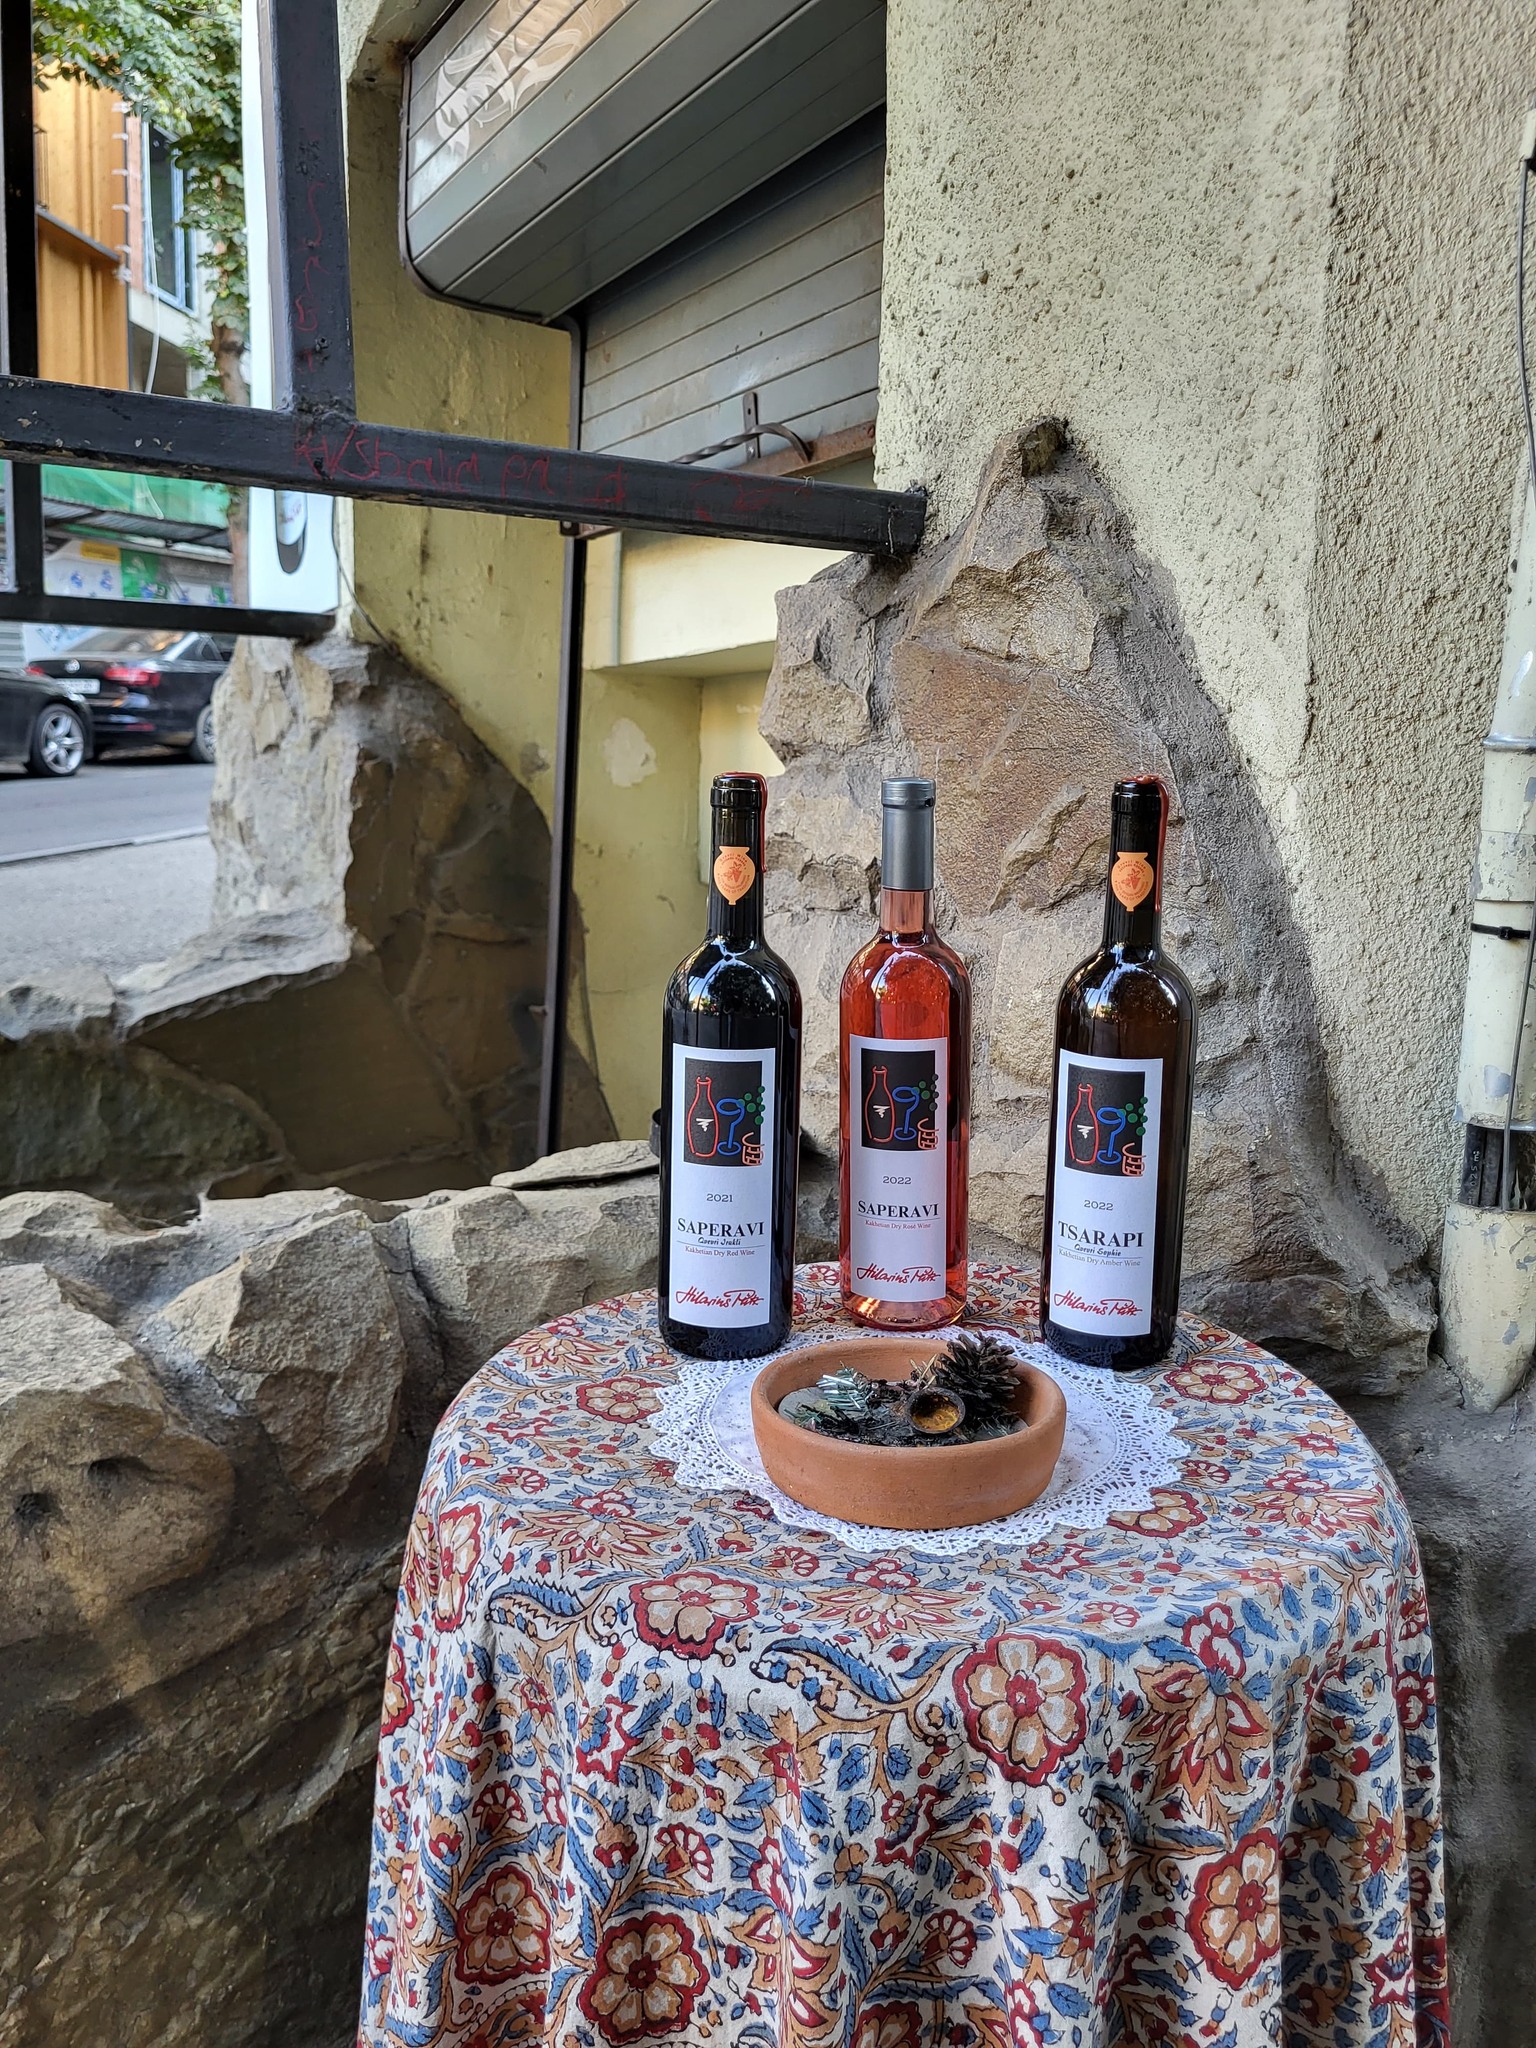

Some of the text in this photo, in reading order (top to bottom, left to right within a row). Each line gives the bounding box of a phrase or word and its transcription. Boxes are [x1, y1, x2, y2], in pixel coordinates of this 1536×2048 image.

[882, 1175, 912, 1185] 2022
[706, 1193, 733, 1203] 2021
[1084, 1199, 1114, 1211] 2022
[857, 1200, 939, 1218] SAPERAVI
[677, 1217, 765, 1237] SAPERAVI
[1058, 1220, 1144, 1248] TSARAPI
[685, 1245, 713, 1256] Kakhetian
[713, 1249, 725, 1258] Dry
[726, 1249, 739, 1257] Red
[1058, 1248, 1086, 1262] Kakhetian
[1086, 1256, 1099, 1265] Dry
[1100, 1259, 1123, 1267] Amber
